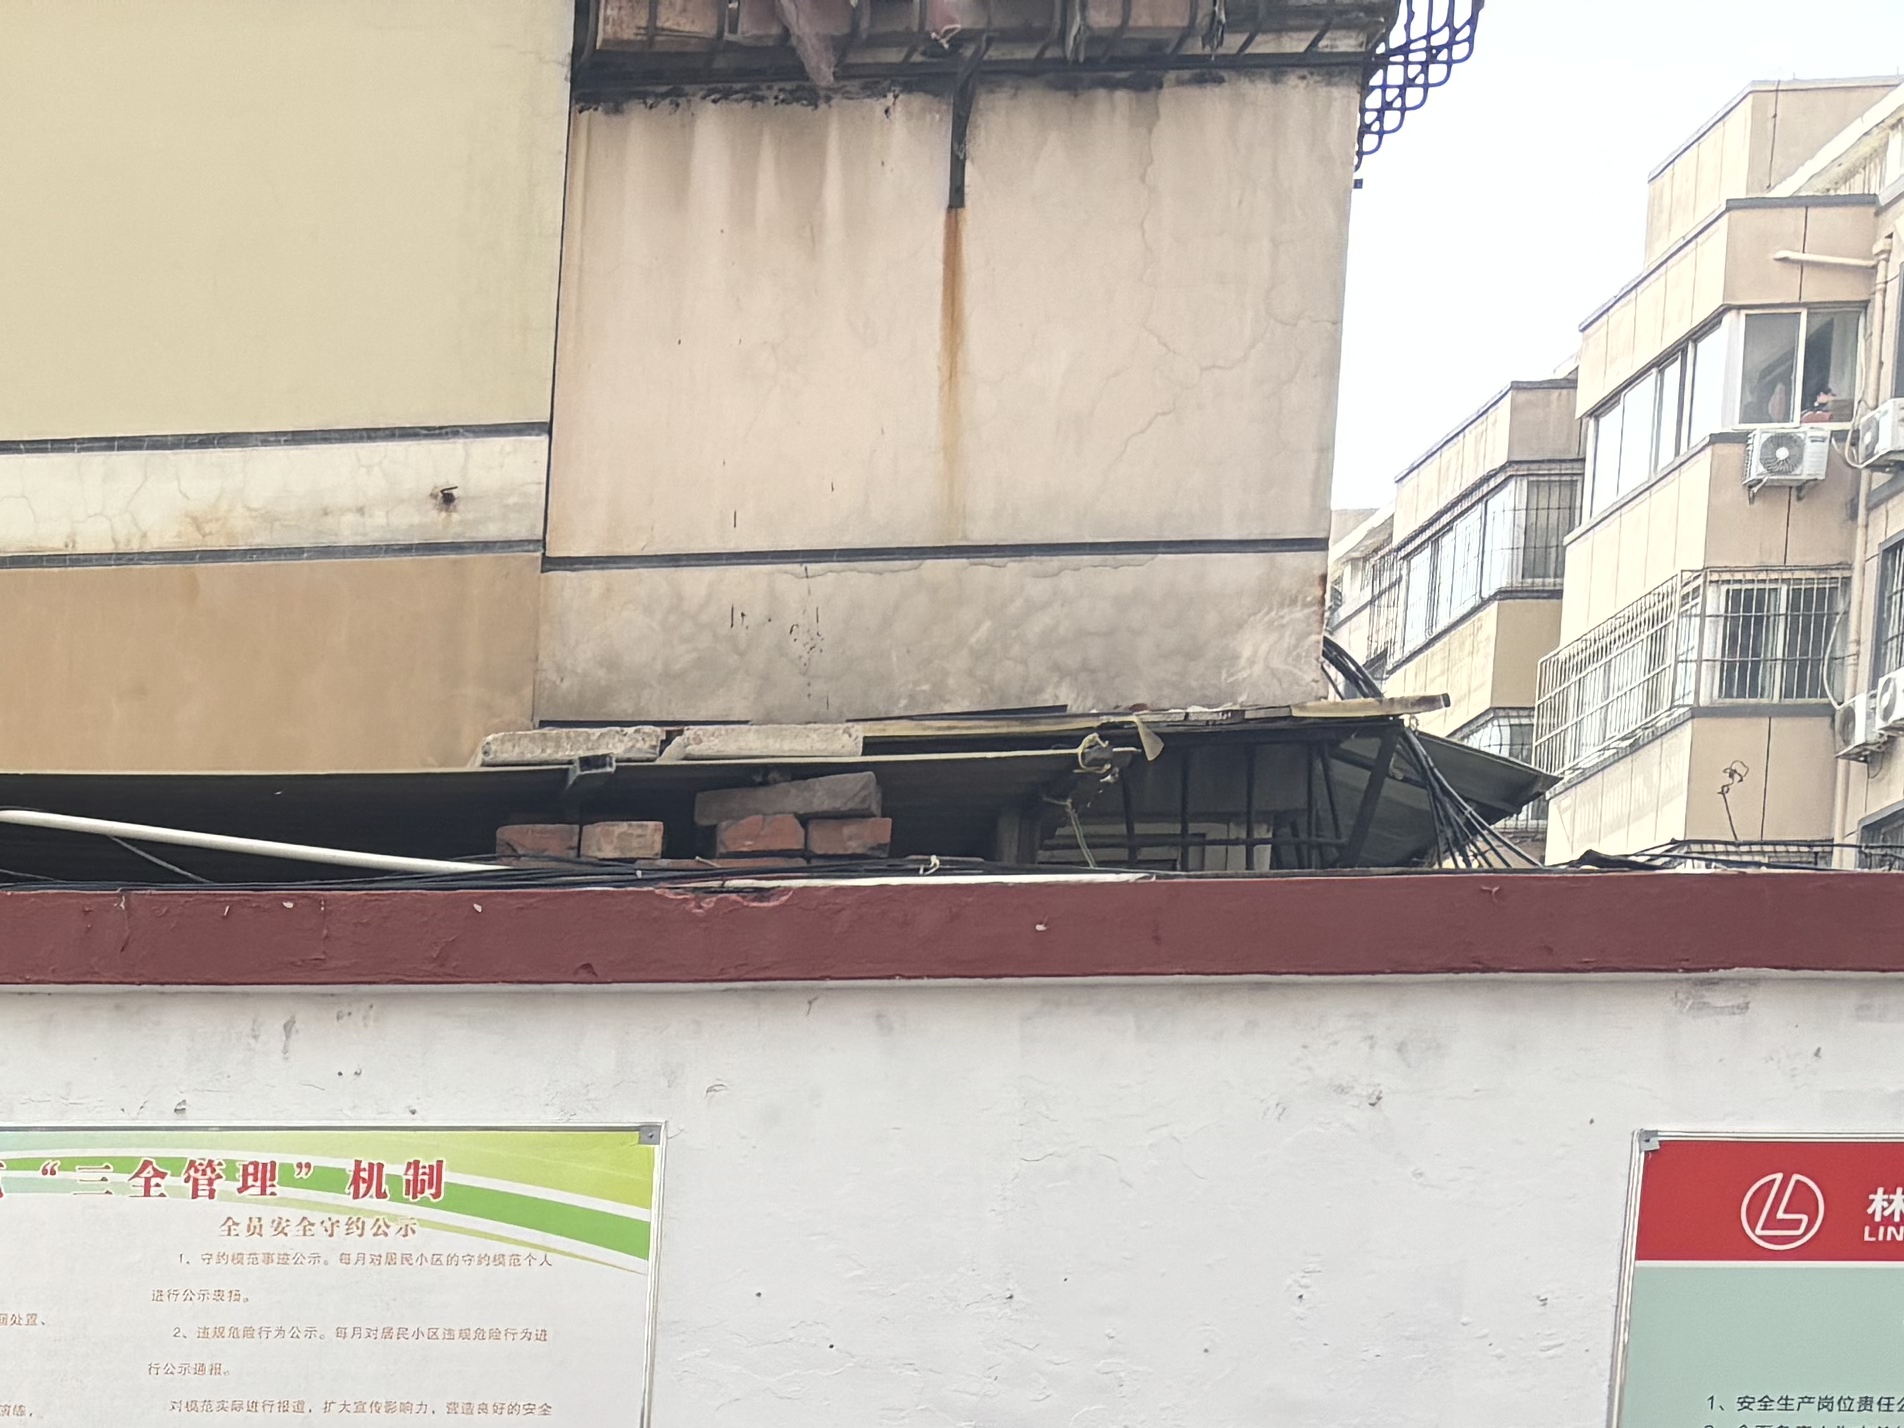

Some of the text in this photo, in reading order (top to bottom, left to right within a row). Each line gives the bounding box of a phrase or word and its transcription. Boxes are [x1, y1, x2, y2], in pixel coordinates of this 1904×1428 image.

[219, 1215, 420, 1239] 全员安全守约公示
